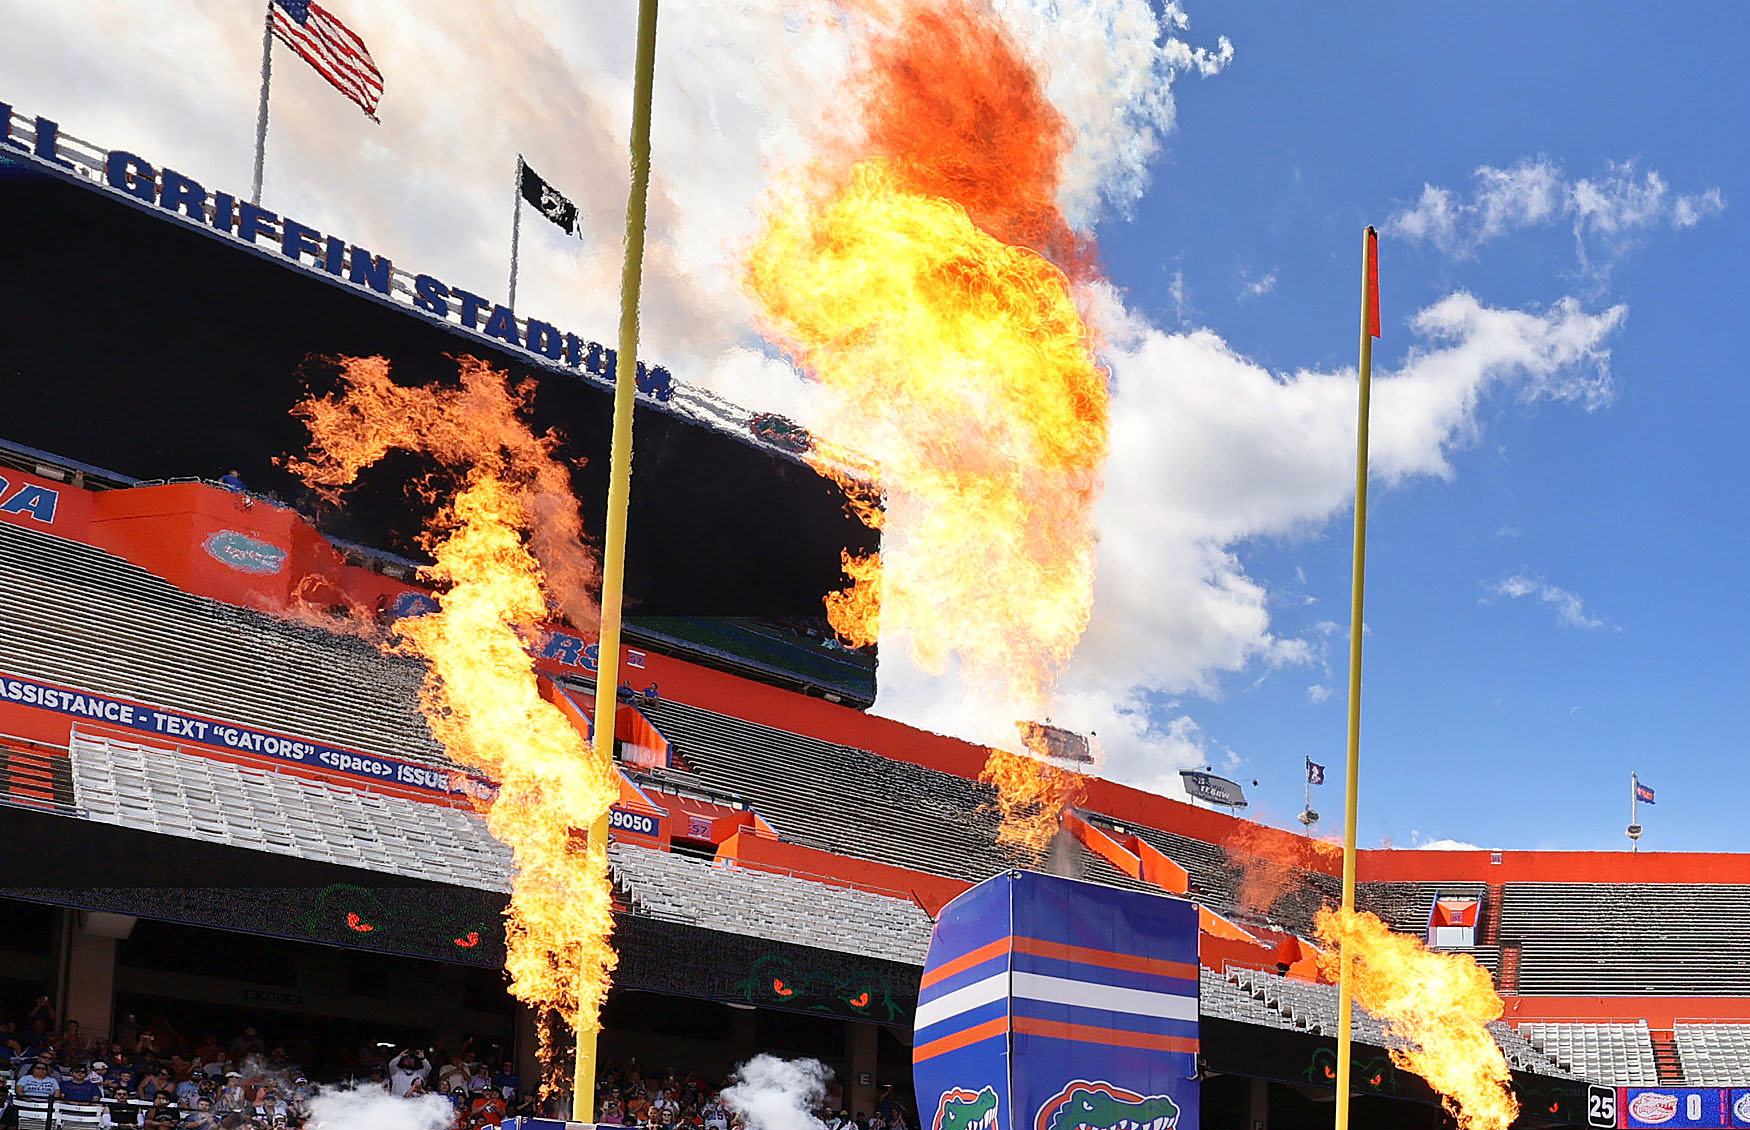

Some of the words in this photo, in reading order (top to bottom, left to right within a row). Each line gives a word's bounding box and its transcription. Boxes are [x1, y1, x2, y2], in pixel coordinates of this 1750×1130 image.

[107, 150, 392, 295] GRIFFIN
[0, 475, 60, 524] A
[0, 679, 133, 724] ASSISTANCE
[153, 712, 208, 740] TEXT
[319, 751, 393, 776] <space>
[1590, 1095, 1614, 1119] 25
[1686, 1094, 1702, 1121] 0
